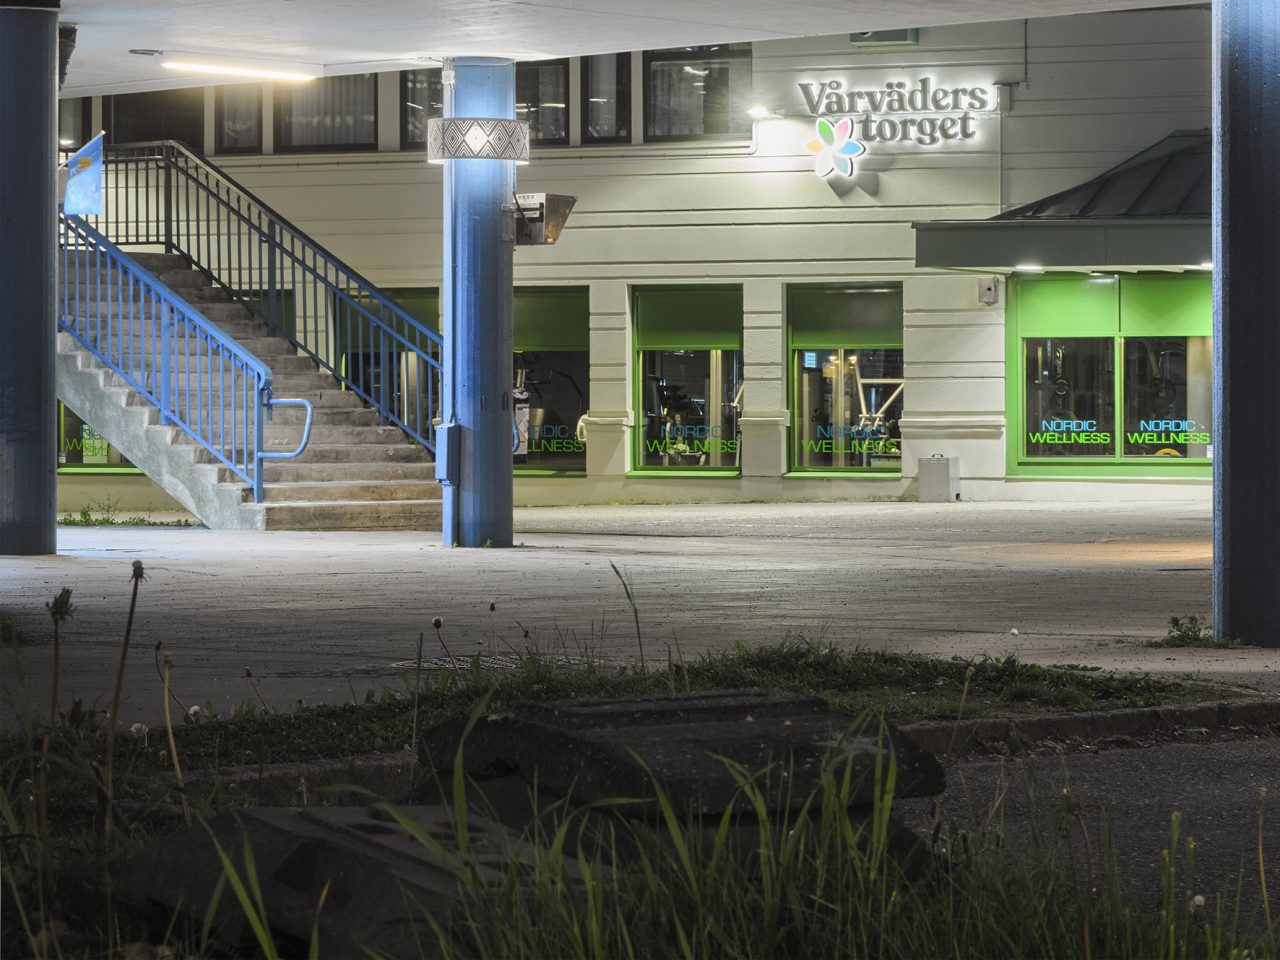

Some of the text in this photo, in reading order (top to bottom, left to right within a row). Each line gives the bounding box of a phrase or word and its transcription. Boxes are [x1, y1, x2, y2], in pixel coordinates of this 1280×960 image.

[798, 77, 988, 114] Vårväders
[856, 111, 977, 146] torget
[661, 425, 721, 438] NORDIC
[1041, 420, 1097, 432] NORDIC
[1140, 420, 1197, 432] NORDIC
[1029, 432, 1111, 444] WELLNESS
[1127, 432, 1210, 444] WELLNESS
[646, 439, 739, 452] WELLNESS
[802, 439, 897, 453] WELLNESS
